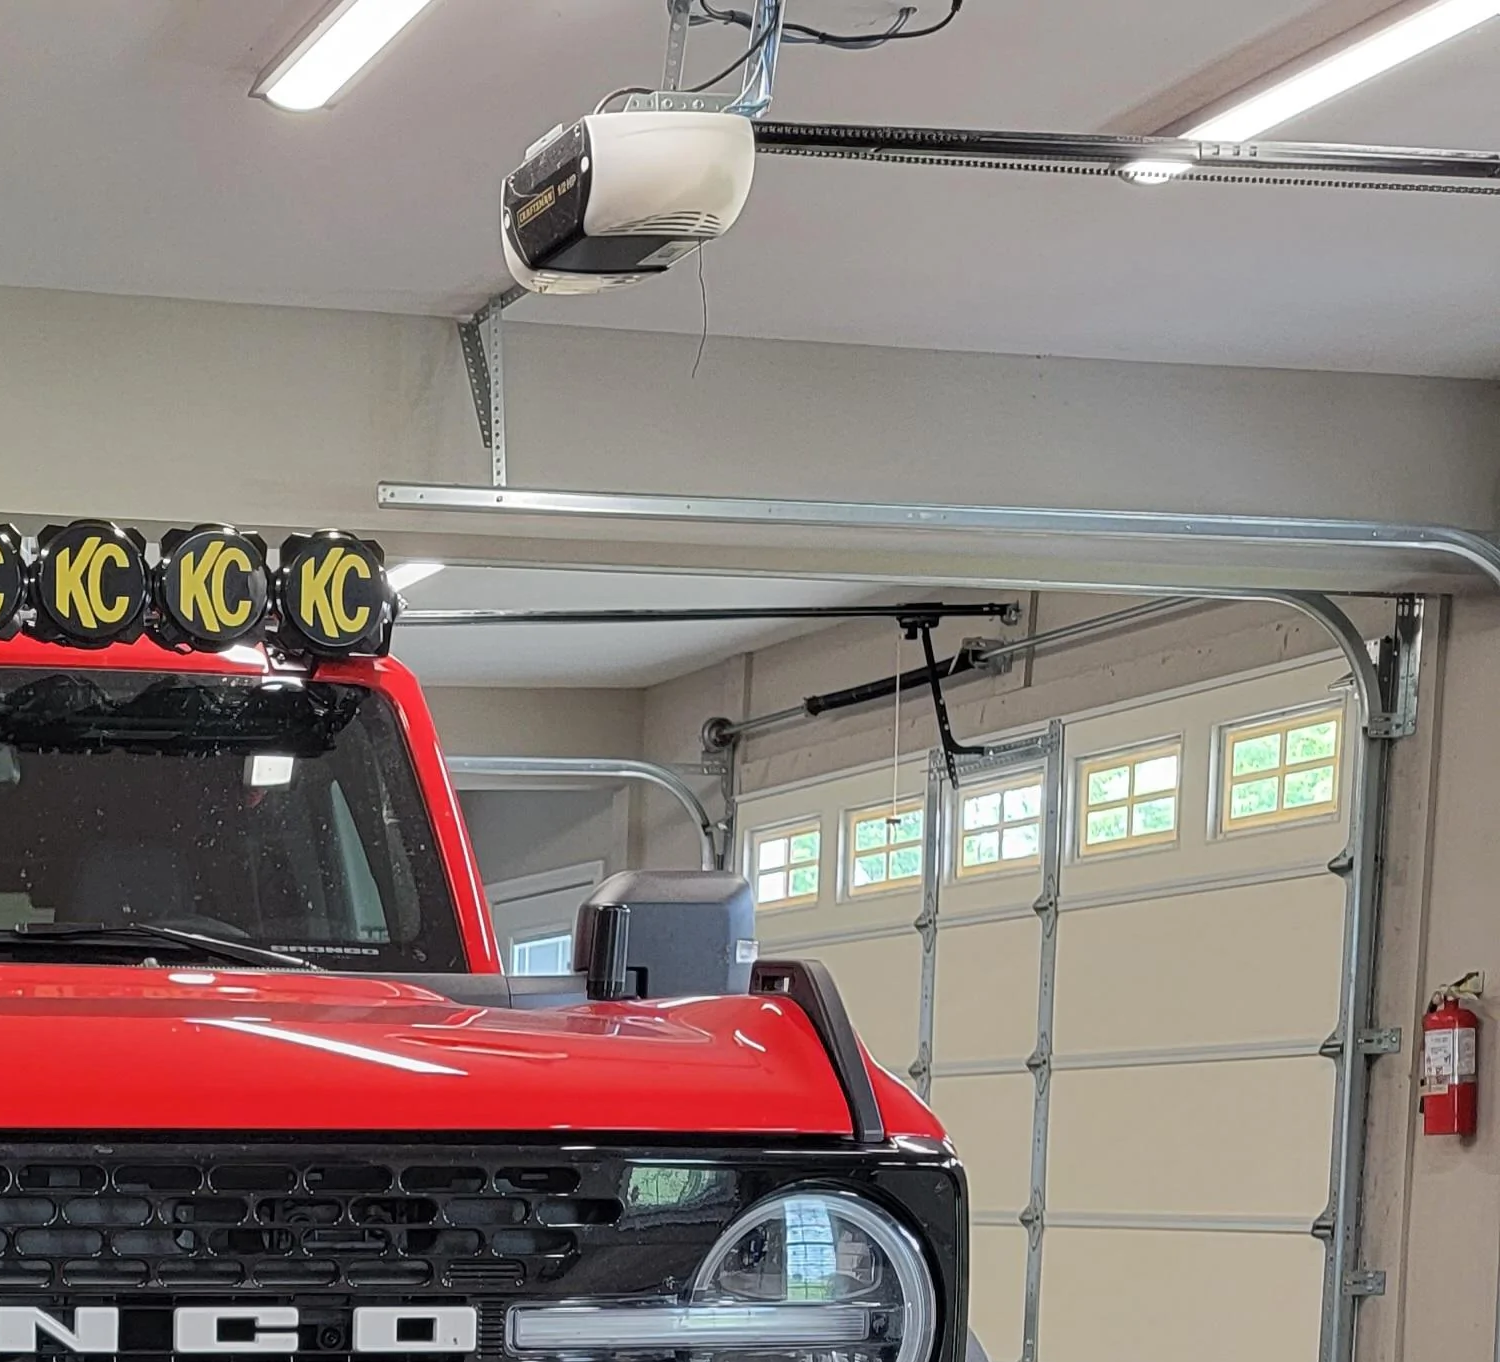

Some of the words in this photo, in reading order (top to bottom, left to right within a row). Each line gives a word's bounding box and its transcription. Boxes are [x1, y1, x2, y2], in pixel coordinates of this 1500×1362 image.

[520, 190, 553, 223] CRAFTSMAN
[55, 537, 129, 629] KC
[181, 541, 252, 632] KC
[301, 547, 370, 638] KC
[270, 945, 380, 956] BRONCO
